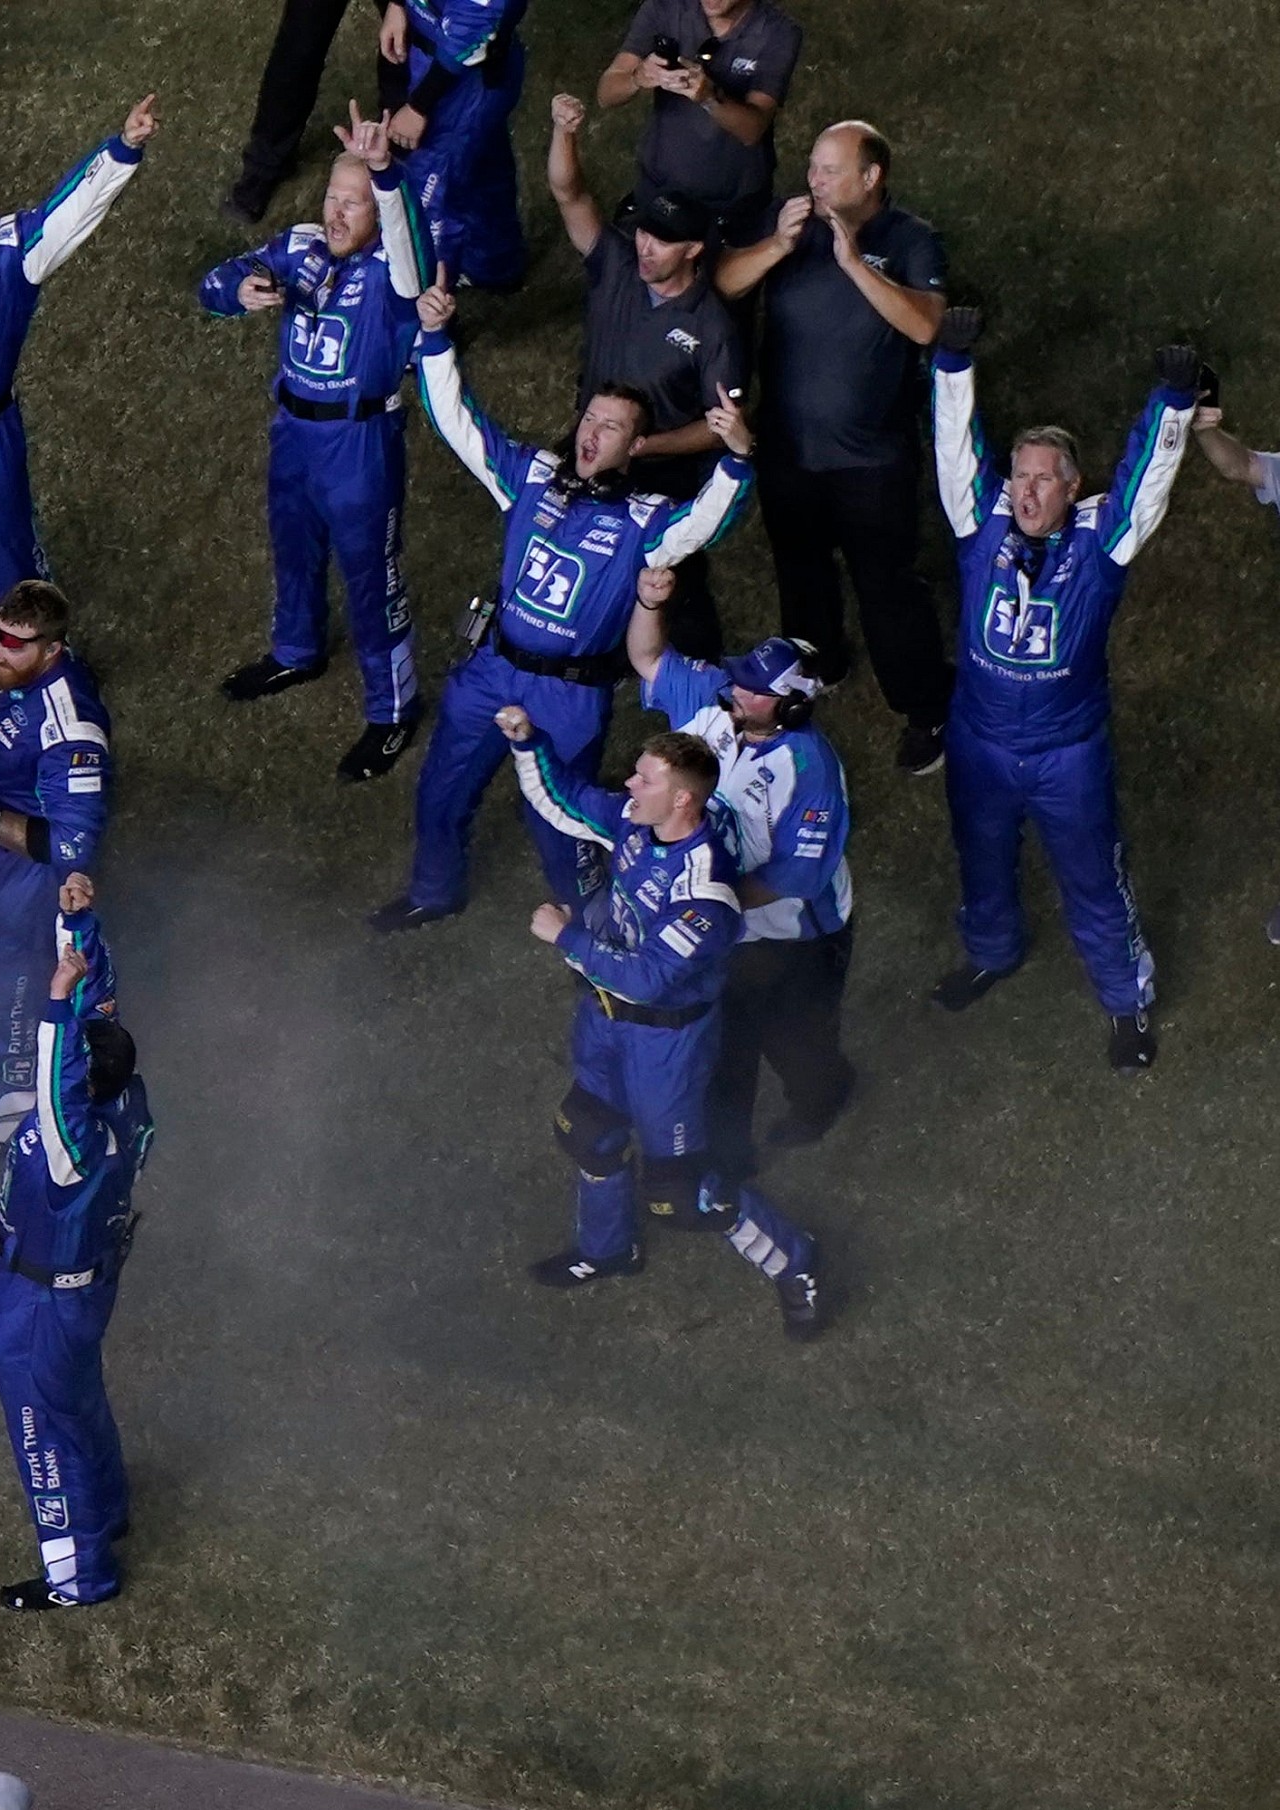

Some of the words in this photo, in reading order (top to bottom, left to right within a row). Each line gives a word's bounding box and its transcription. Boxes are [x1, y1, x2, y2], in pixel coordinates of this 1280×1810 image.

[694, 916, 712, 932] 75
[21, 1405, 37, 1450] THIRD
[27, 1450, 43, 1490] FIFTH
[43, 1448, 61, 1490] BANK
